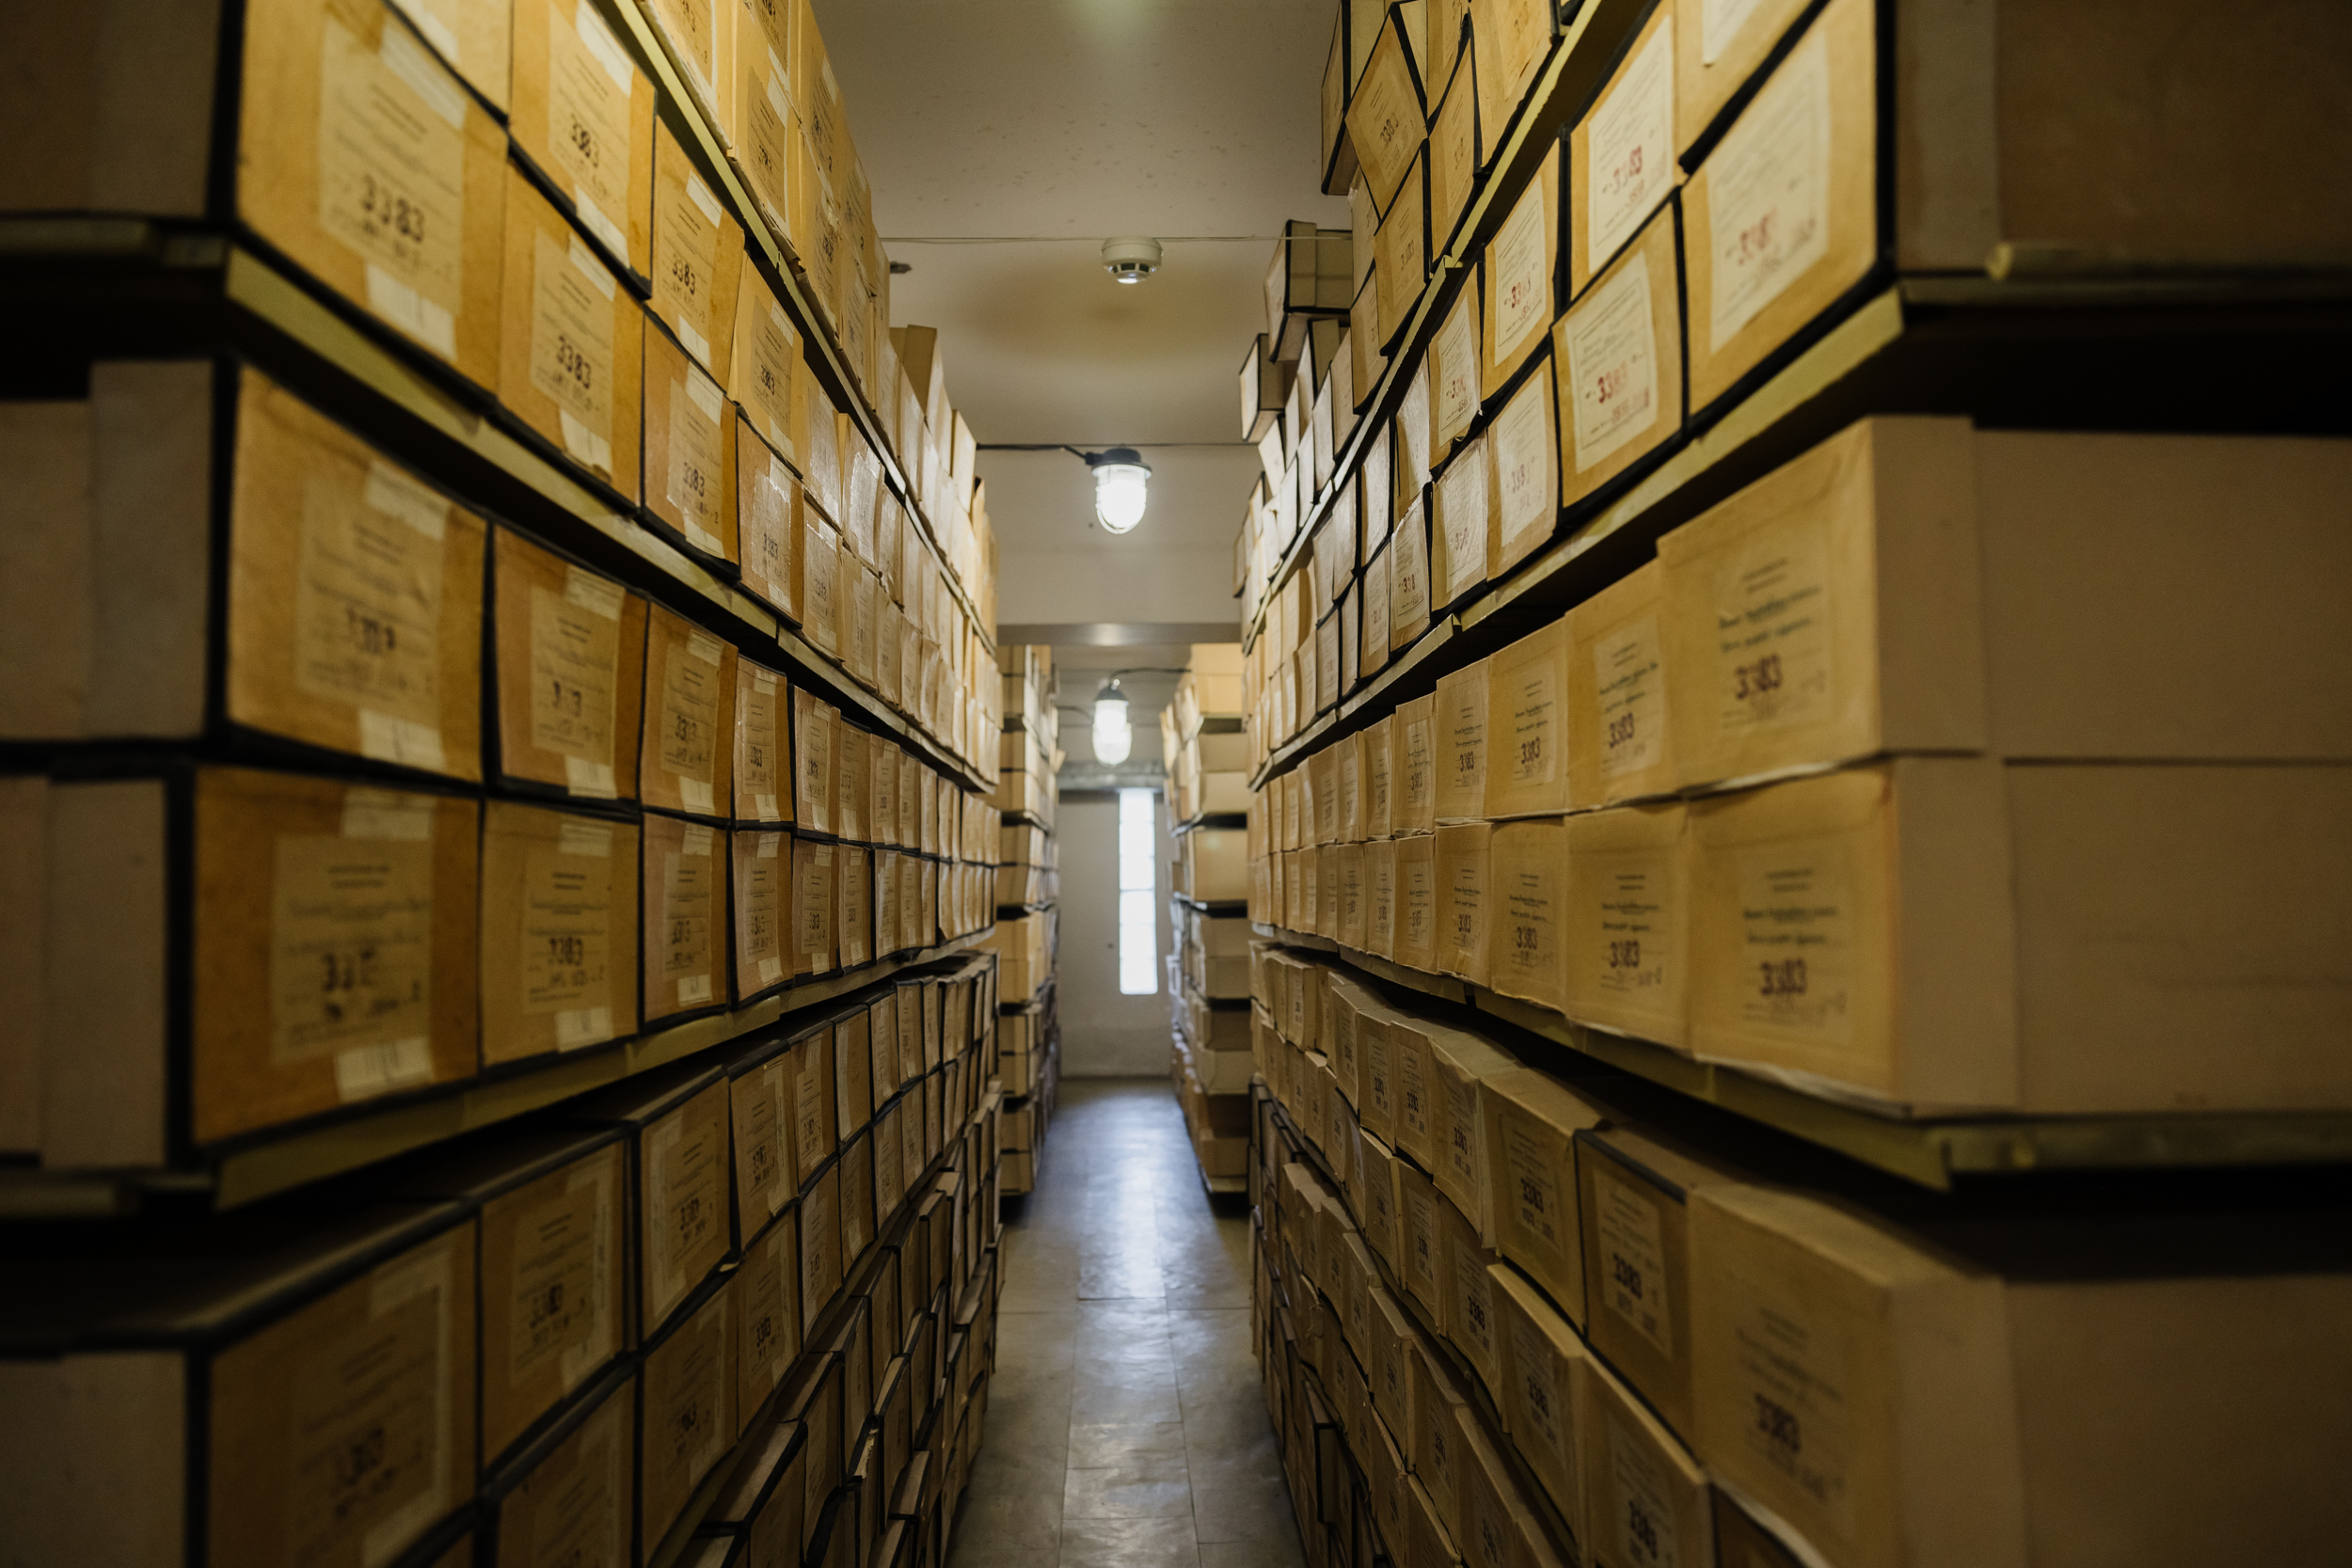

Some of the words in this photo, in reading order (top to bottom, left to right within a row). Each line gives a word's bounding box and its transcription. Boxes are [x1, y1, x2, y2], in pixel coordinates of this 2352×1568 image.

[673, 253, 695, 295] 3383
[556, 335, 592, 389] 3383
[760, 364, 775, 395] 3383
[682, 461, 705, 497] 3383
[1459, 751, 1474, 772] 3383
[1521, 736, 1540, 765] 3383
[756, 1316, 771, 1347] 3383
